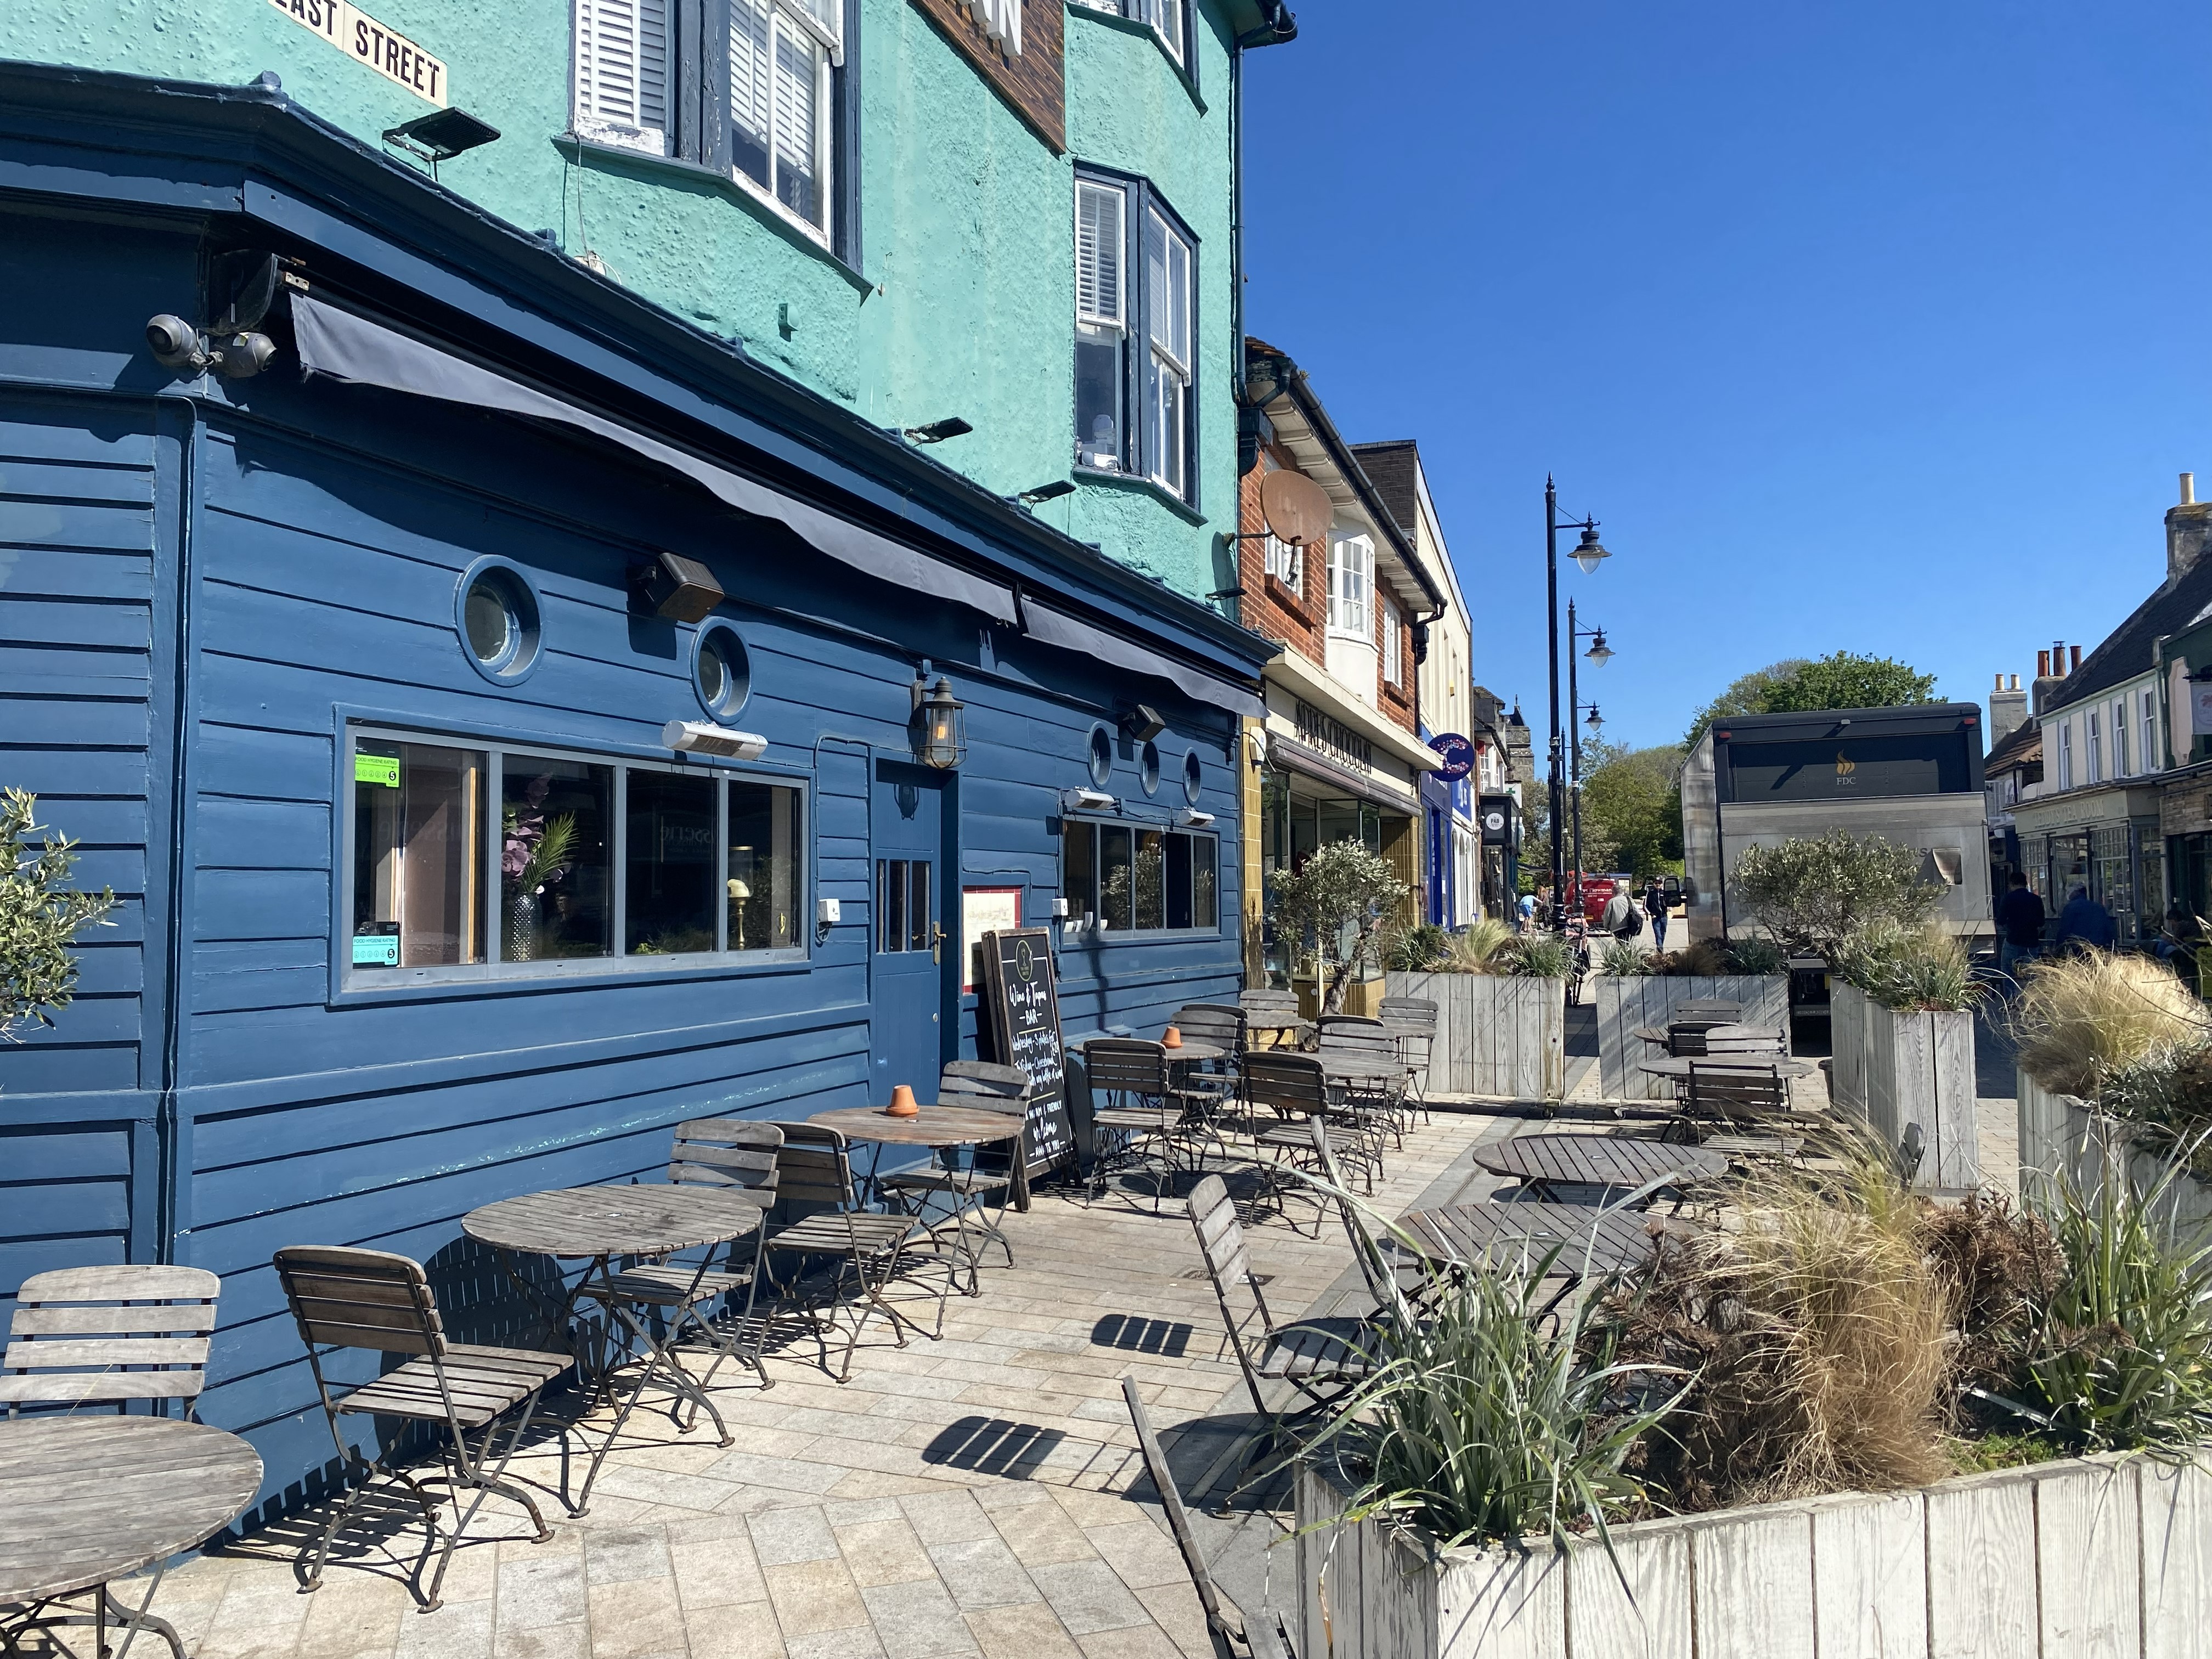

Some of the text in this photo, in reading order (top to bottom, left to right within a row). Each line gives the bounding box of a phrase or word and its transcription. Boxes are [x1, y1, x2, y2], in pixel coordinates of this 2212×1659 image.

[274, 0, 439, 98] AST STREET
[1836, 777, 1857, 786] FDC
[2062, 804, 2078, 821] TEA
[2080, 798, 2104, 820] ROOM
[1009, 981, 1047, 1007] Wine & Tapas
[1046, 1099, 1062, 1114] FRIENDLY
[1051, 1139, 1060, 1152] YOU
